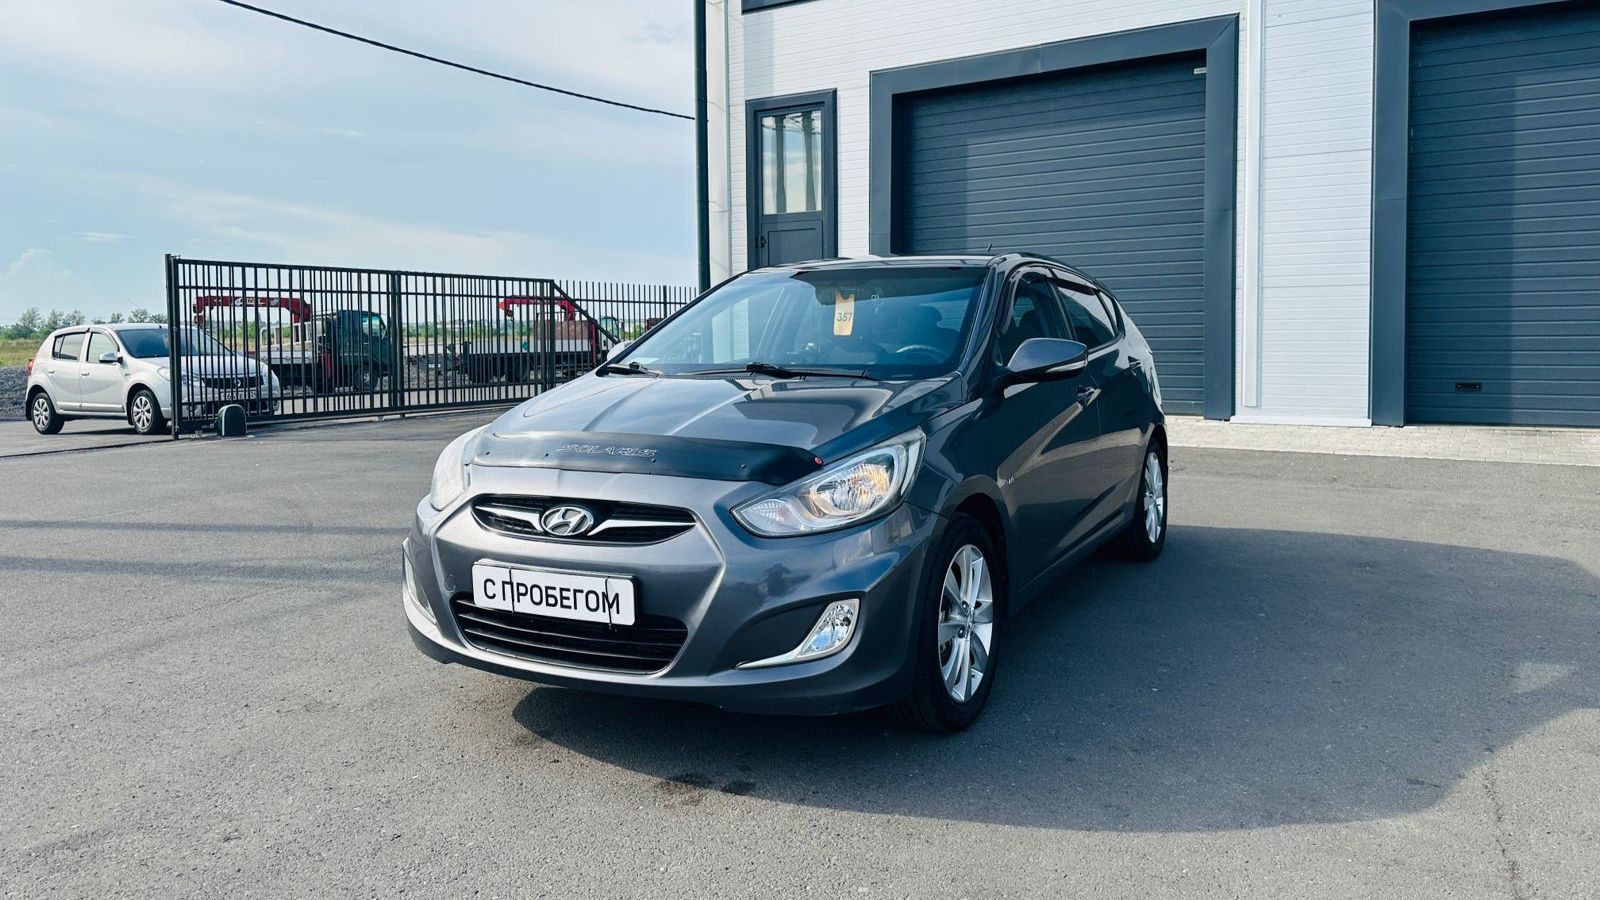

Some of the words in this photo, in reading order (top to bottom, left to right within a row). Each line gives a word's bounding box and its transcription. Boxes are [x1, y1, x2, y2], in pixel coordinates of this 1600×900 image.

[837, 312, 853, 322] 357
[483, 578, 497, 600] С
[501, 581, 620, 615] ПРОБЕГОМ
